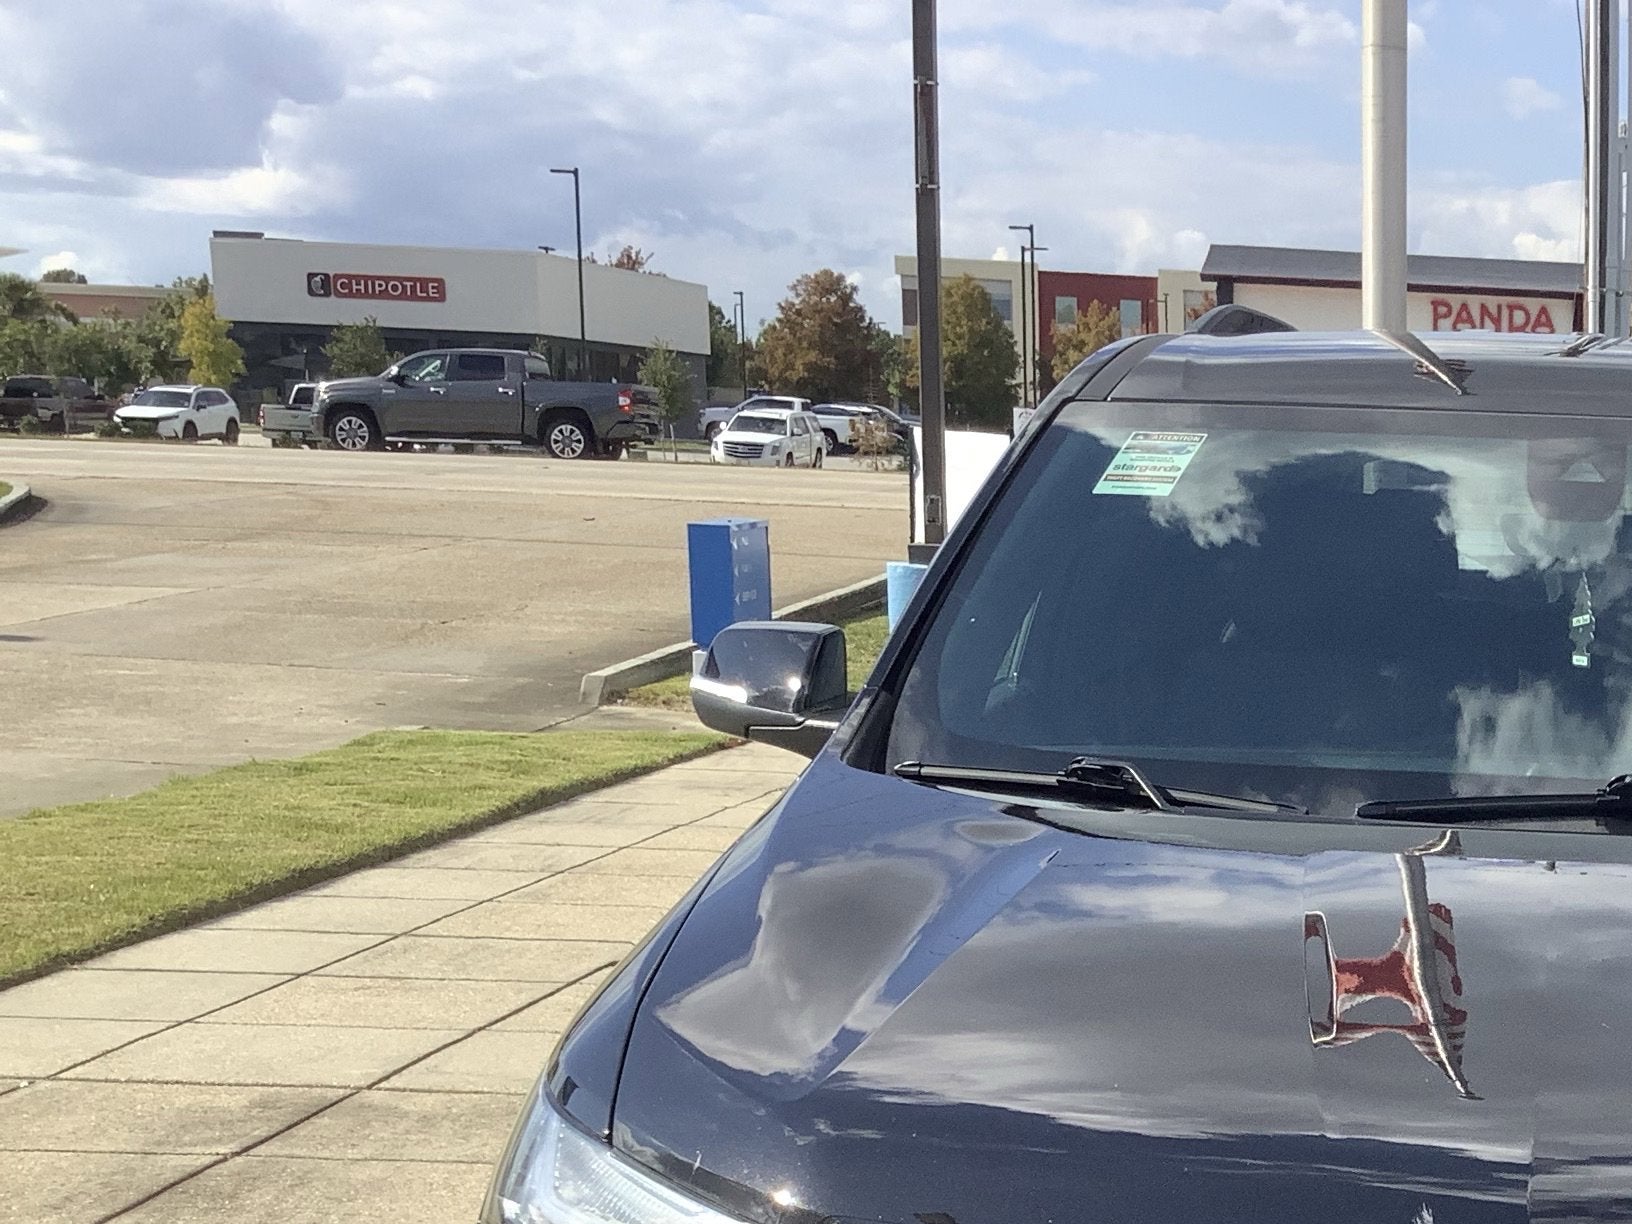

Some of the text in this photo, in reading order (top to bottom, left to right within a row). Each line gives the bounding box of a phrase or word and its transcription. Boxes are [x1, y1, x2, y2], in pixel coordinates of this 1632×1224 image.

[336, 278, 440, 298] CHIPOTLE
[1430, 299, 1556, 333] PANDA
[1151, 433, 1202, 442] ATTENTION
